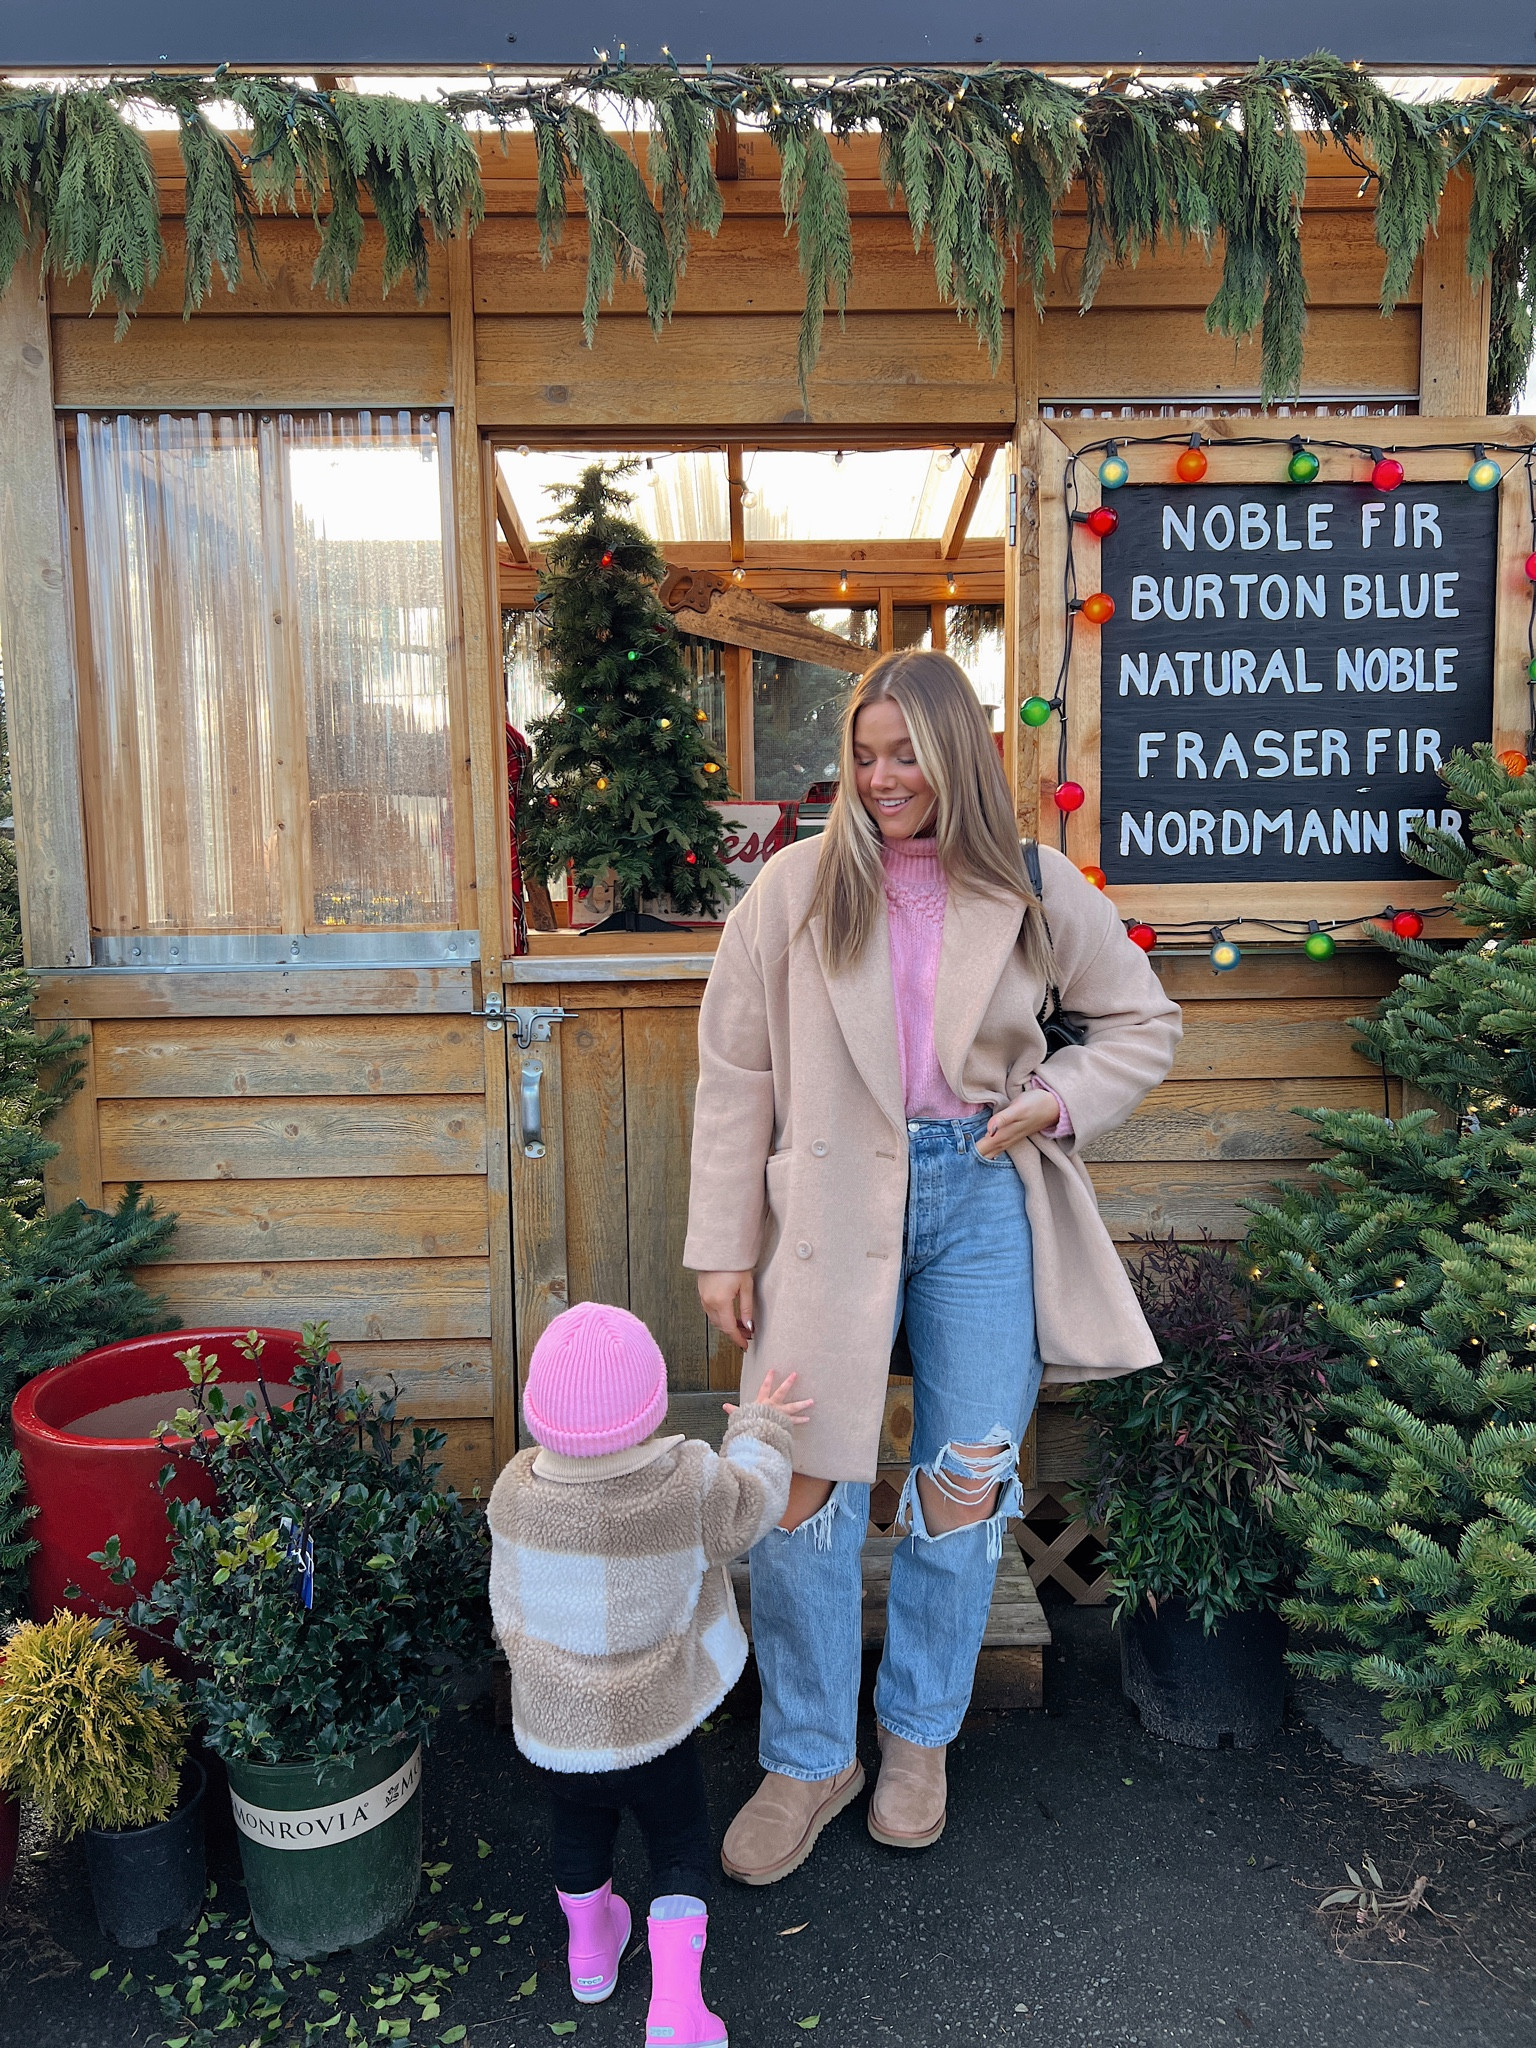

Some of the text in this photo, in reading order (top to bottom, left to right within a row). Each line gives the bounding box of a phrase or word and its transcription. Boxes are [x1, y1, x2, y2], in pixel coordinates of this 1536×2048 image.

[1162, 502, 1443, 552] NOBLE FIR
[1131, 571, 1460, 621] BURTON BLUE
[1119, 647, 1459, 697] NATURAL NOBLE
[1138, 728, 1443, 780] FRASER FIR
[1119, 808, 1389, 857] NORDMANN
[233, 1801, 369, 1840] MONROVIA
